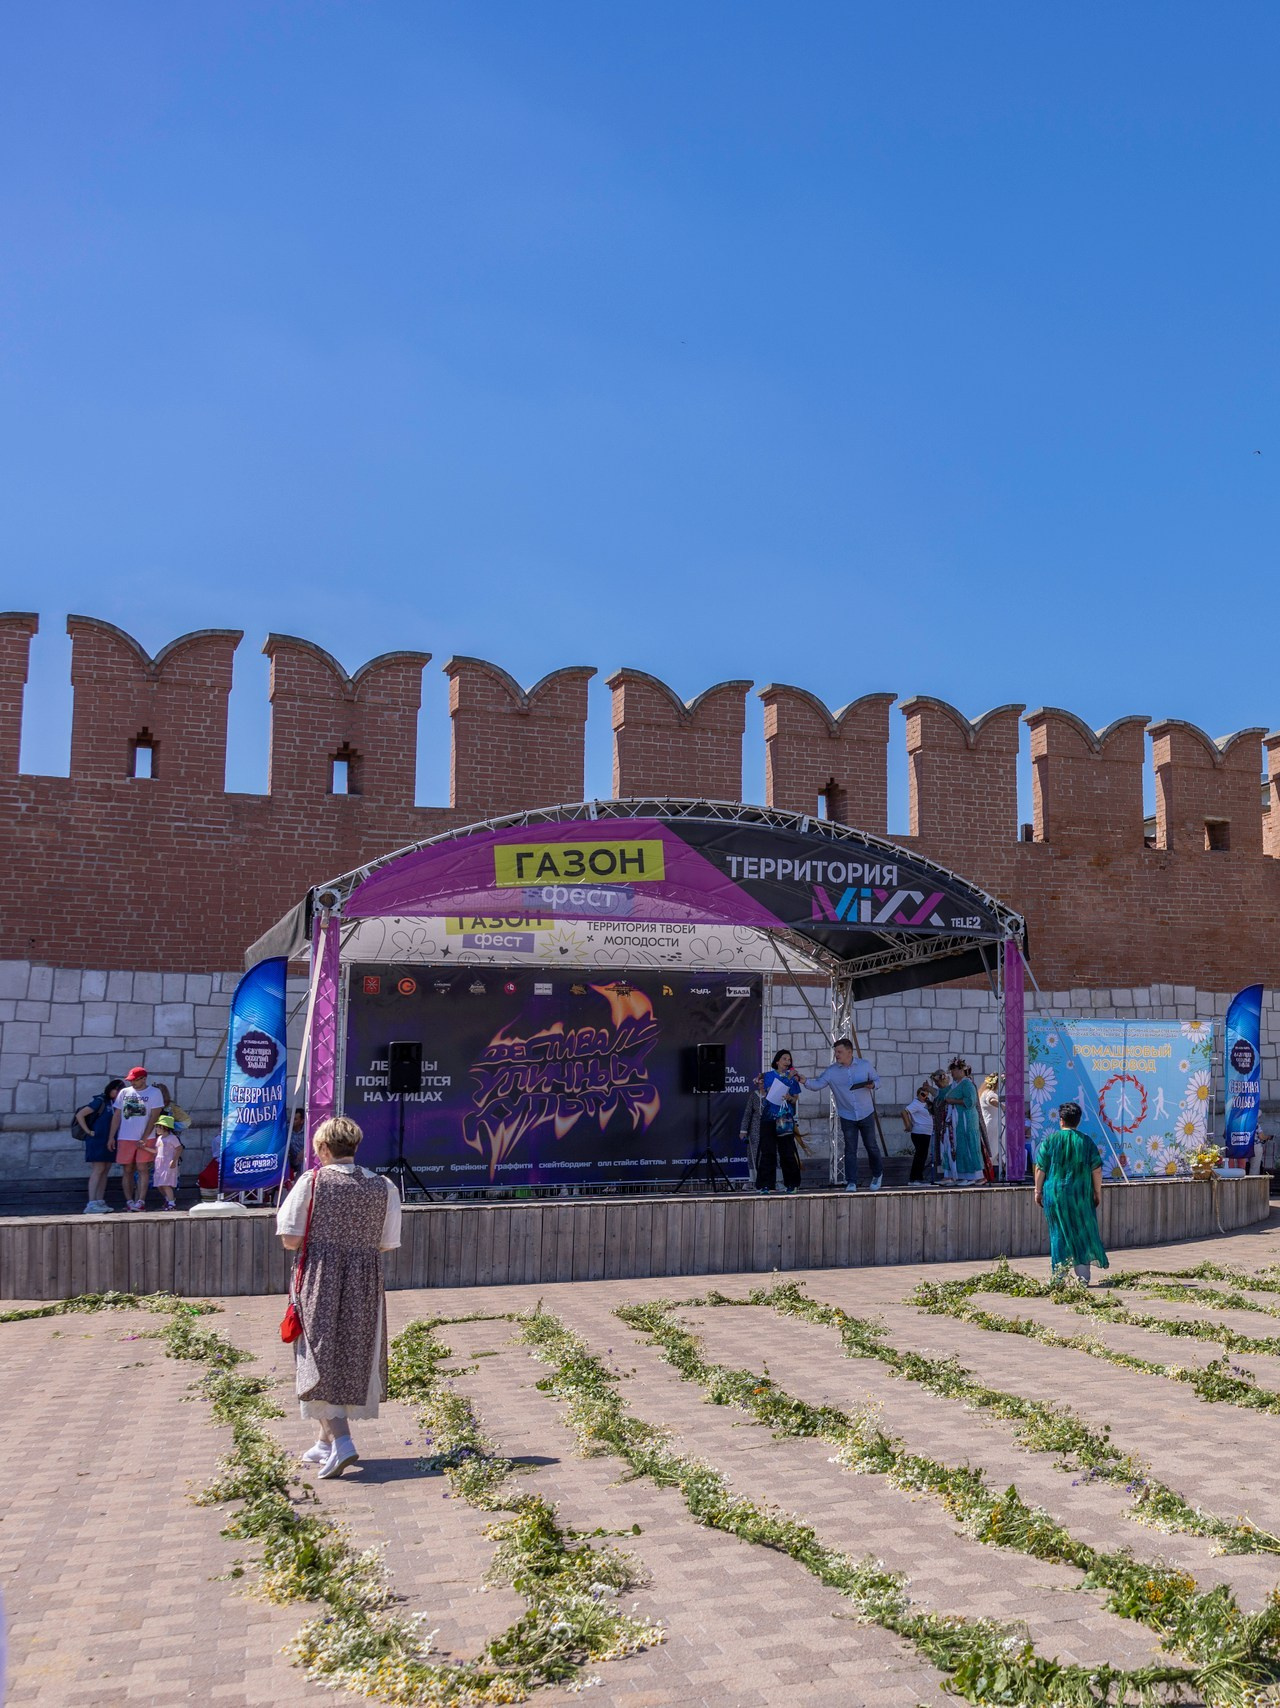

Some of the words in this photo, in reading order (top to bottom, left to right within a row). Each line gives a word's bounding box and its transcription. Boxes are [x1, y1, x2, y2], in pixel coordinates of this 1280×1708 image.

[515, 848, 645, 879] ГАЗОН
[726, 855, 898, 886] ТЕРРИТОРИЯ
[541, 885, 617, 910] фест
[586, 921, 657, 933] ТЕРРИТОРИЯ
[659, 922, 696, 935] ТВОЕЙ
[950, 916, 982, 930] TELE2
[474, 933, 524, 949] фест
[603, 935, 680, 948] МОЛОДОСТИ
[1073, 1043, 1172, 1058] РОМАШКОВЫЙ
[1092, 1059, 1157, 1073] ХОРОВОД
[230, 1084, 283, 1104] СЕВЕРНАЯ
[1229, 1080, 1260, 1094] СЕВЕРНАЯ
[363, 1091, 383, 1102] НА
[1232, 1096, 1256, 1109] ХОДЬБА
[236, 1104, 278, 1126] ХОДЬБА
[1114, 1142, 1133, 1150] ТУЛА
[450, 1163, 489, 1172] брейкинг
[494, 1162, 533, 1171] граффити
[538, 1160, 592, 1169] скейтбординг
[640, 1157, 667, 1166] баттлы
